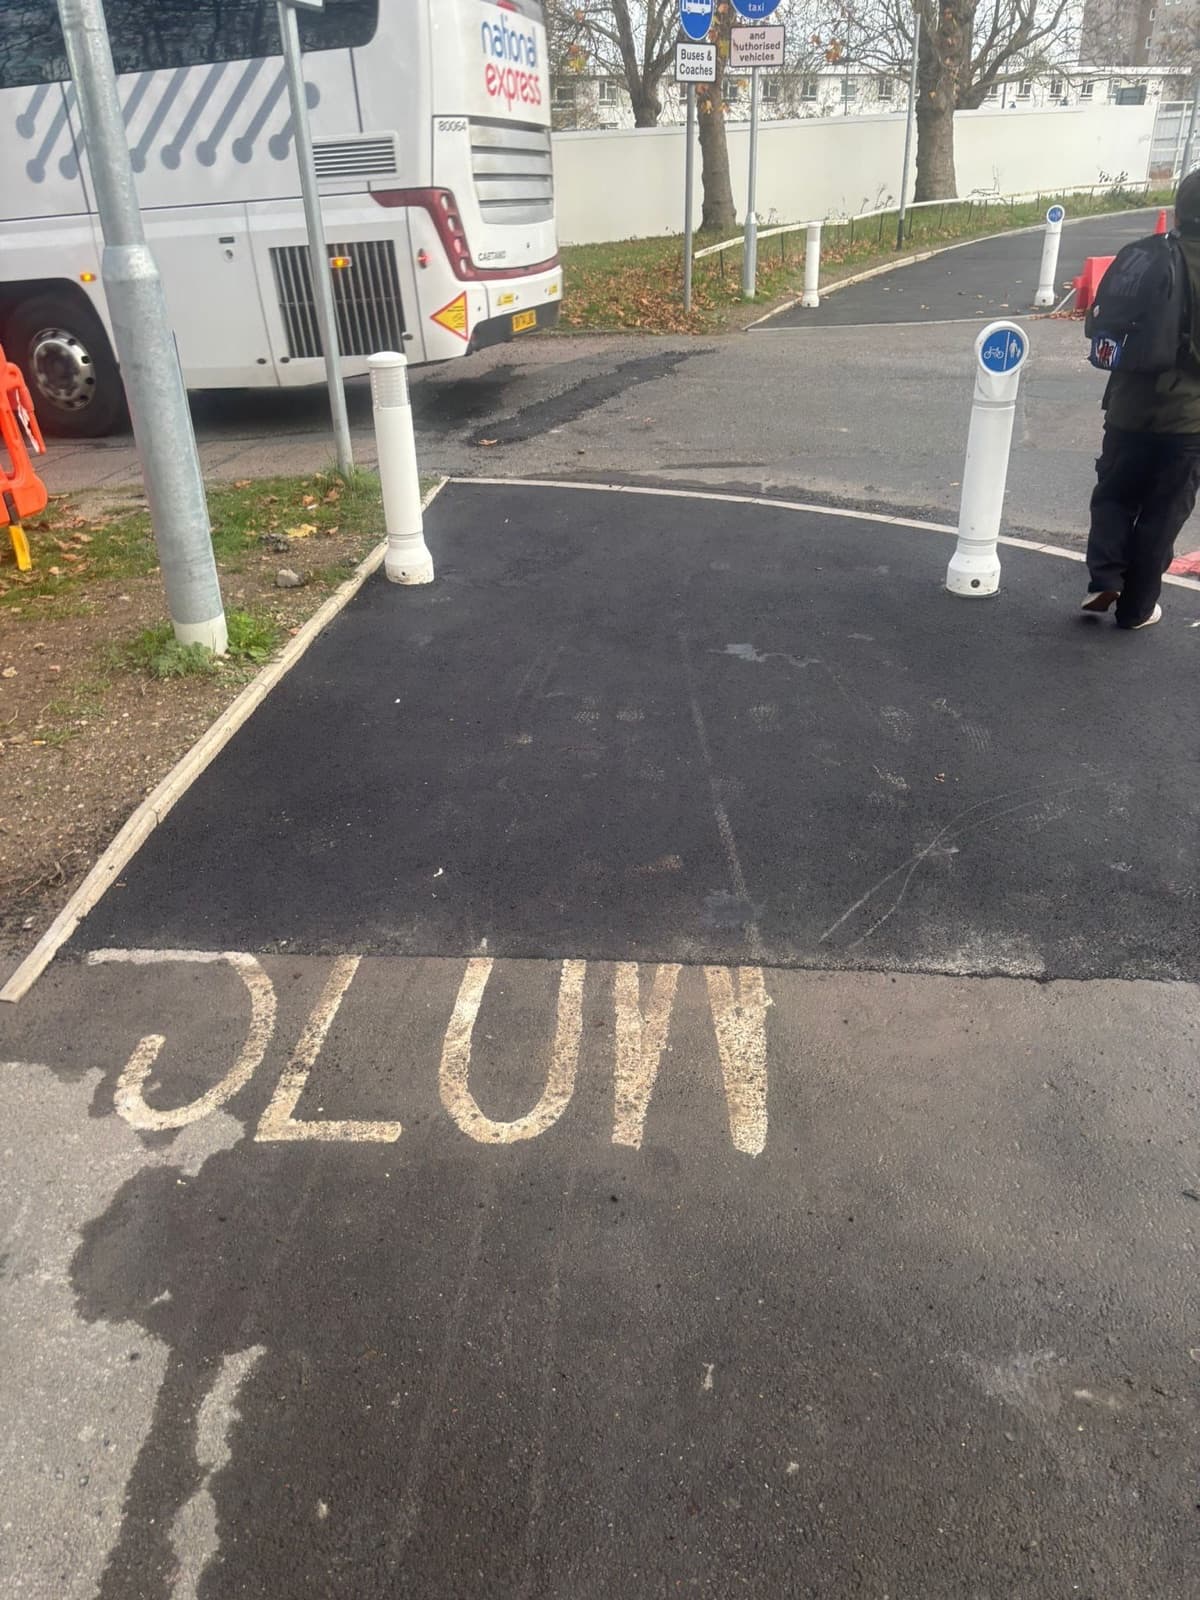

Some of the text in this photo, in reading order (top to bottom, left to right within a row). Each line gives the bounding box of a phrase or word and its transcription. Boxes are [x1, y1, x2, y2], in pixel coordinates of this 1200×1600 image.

[748, 3, 765, 12] taxi
[481, 13, 537, 67] national
[749, 31, 766, 40] and
[681, 48, 713, 61] Buses &
[739, 52, 775, 61] vehicles
[679, 63, 713, 76] Coaches
[485, 63, 541, 112] express
